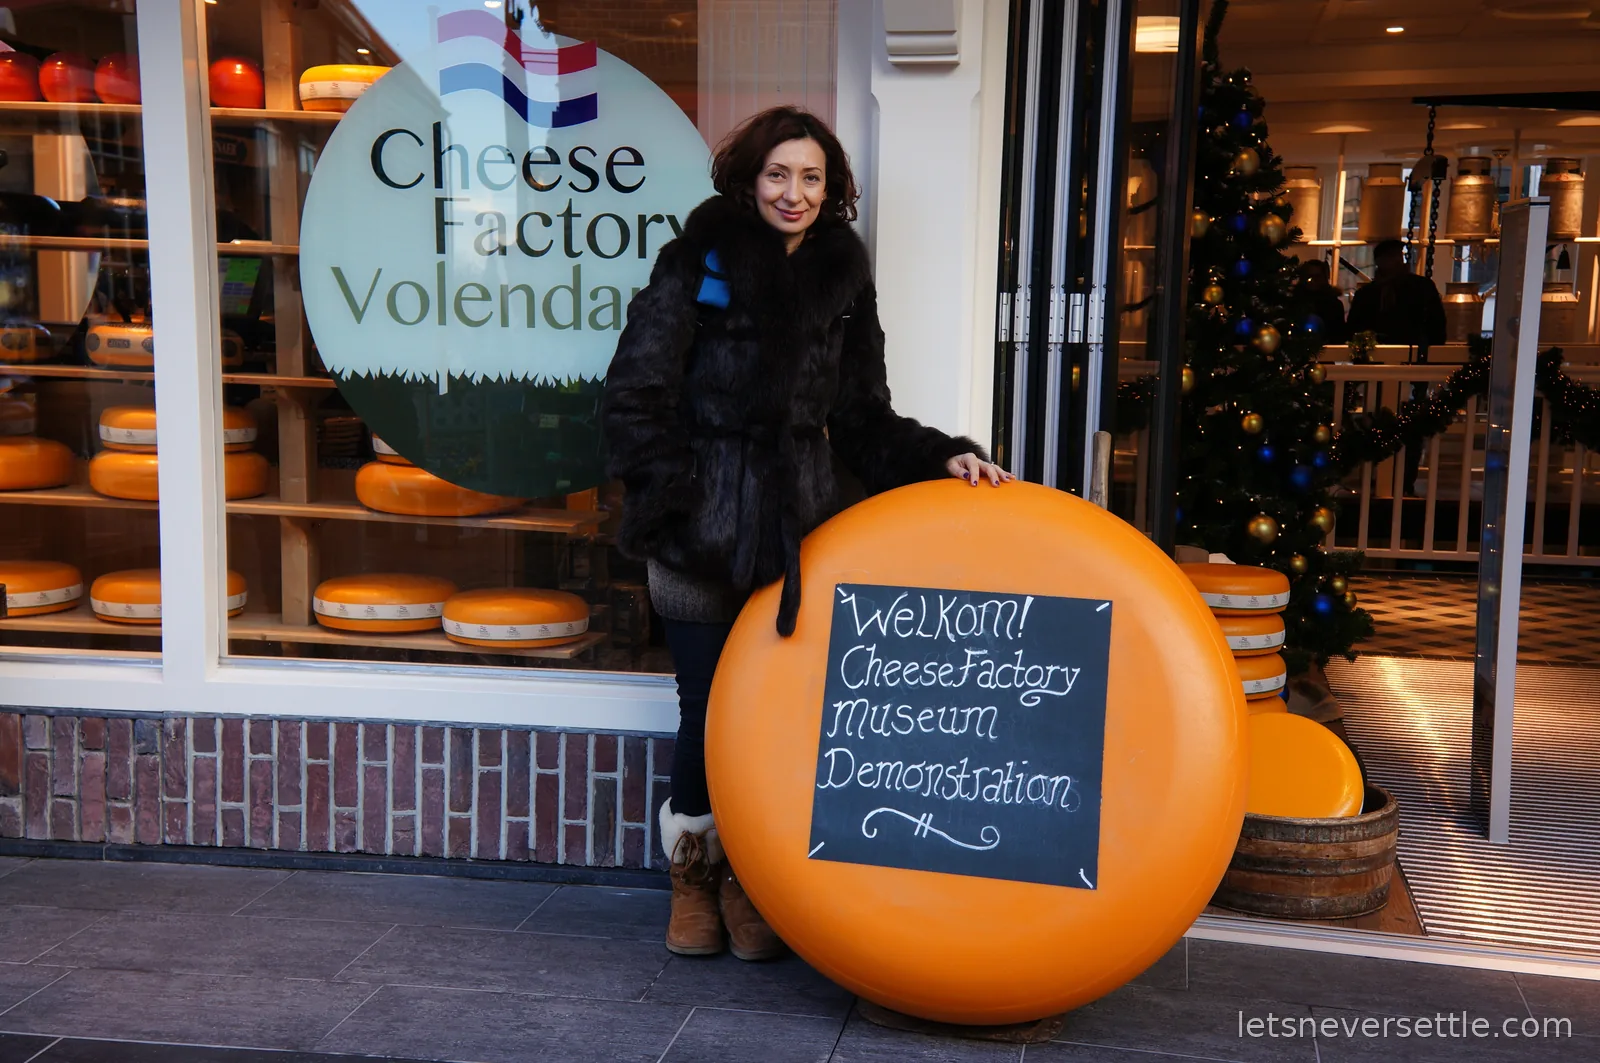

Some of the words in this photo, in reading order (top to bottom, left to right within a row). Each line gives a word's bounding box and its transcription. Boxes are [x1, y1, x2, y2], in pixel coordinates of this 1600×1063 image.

[370, 121, 646, 194] Cheese
[330, 261, 641, 331] Volenda
[817, 747, 1071, 807] Demonstration
